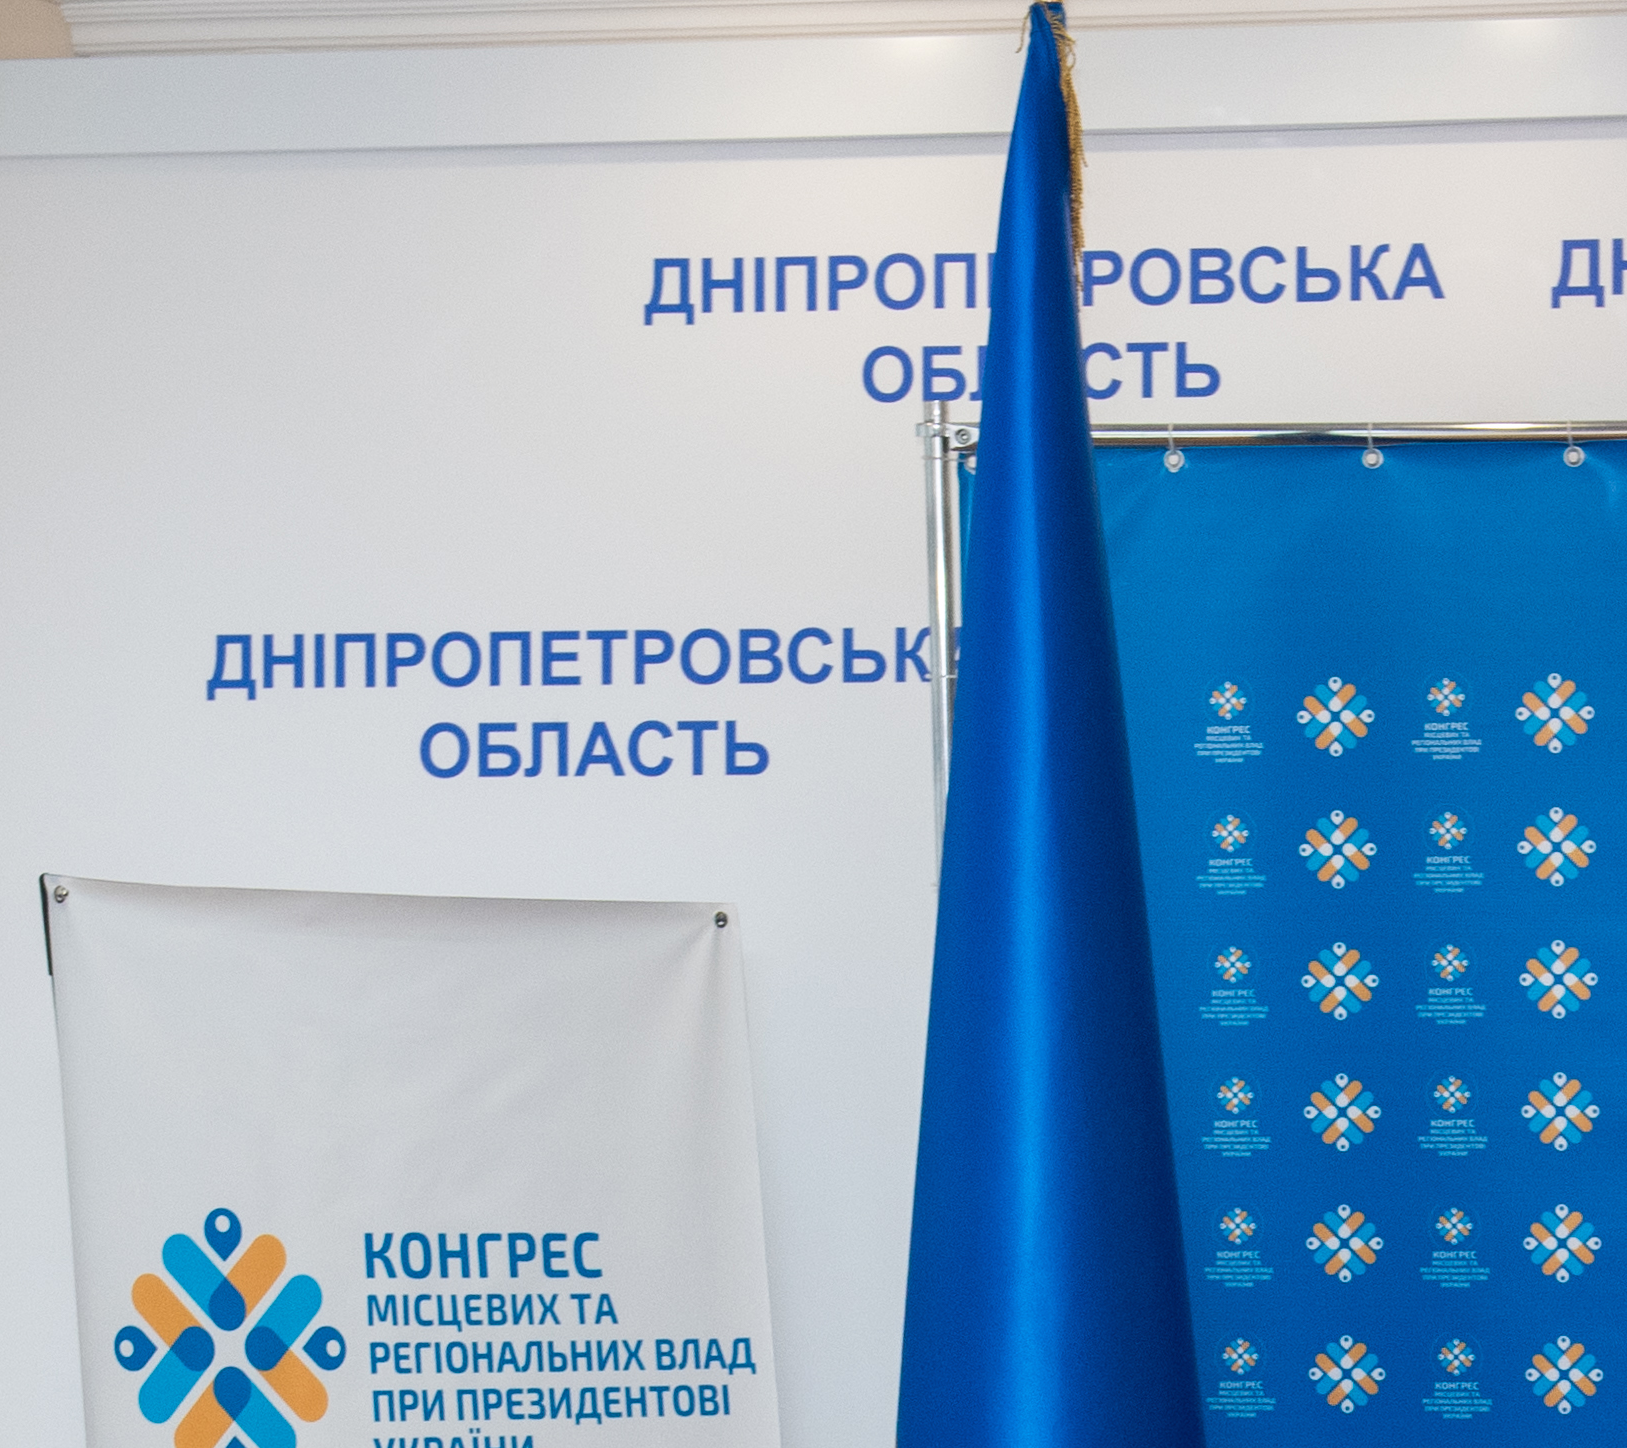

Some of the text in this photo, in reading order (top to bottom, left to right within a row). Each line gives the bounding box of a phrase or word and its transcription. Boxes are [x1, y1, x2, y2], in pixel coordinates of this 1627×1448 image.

[644, 243, 1445, 326] ДНІПРОПРОВСЬКА
[862, 341, 1221, 404] ОБСТЬ
[206, 626, 933, 702] ДНІПРОПЕТРОВСЬК
[419, 719, 770, 779] ОБЛАСТЬ
[363, 1232, 603, 1279] КОНГРЕС
[366, 1293, 618, 1332] МІСЦЕВИХ ТА
[369, 1337, 757, 1375] РЕГІОНАЛЬНИХ ВЛАД
[372, 1385, 731, 1425] ПРИ ПРЕЗИДЕНТОВІ
